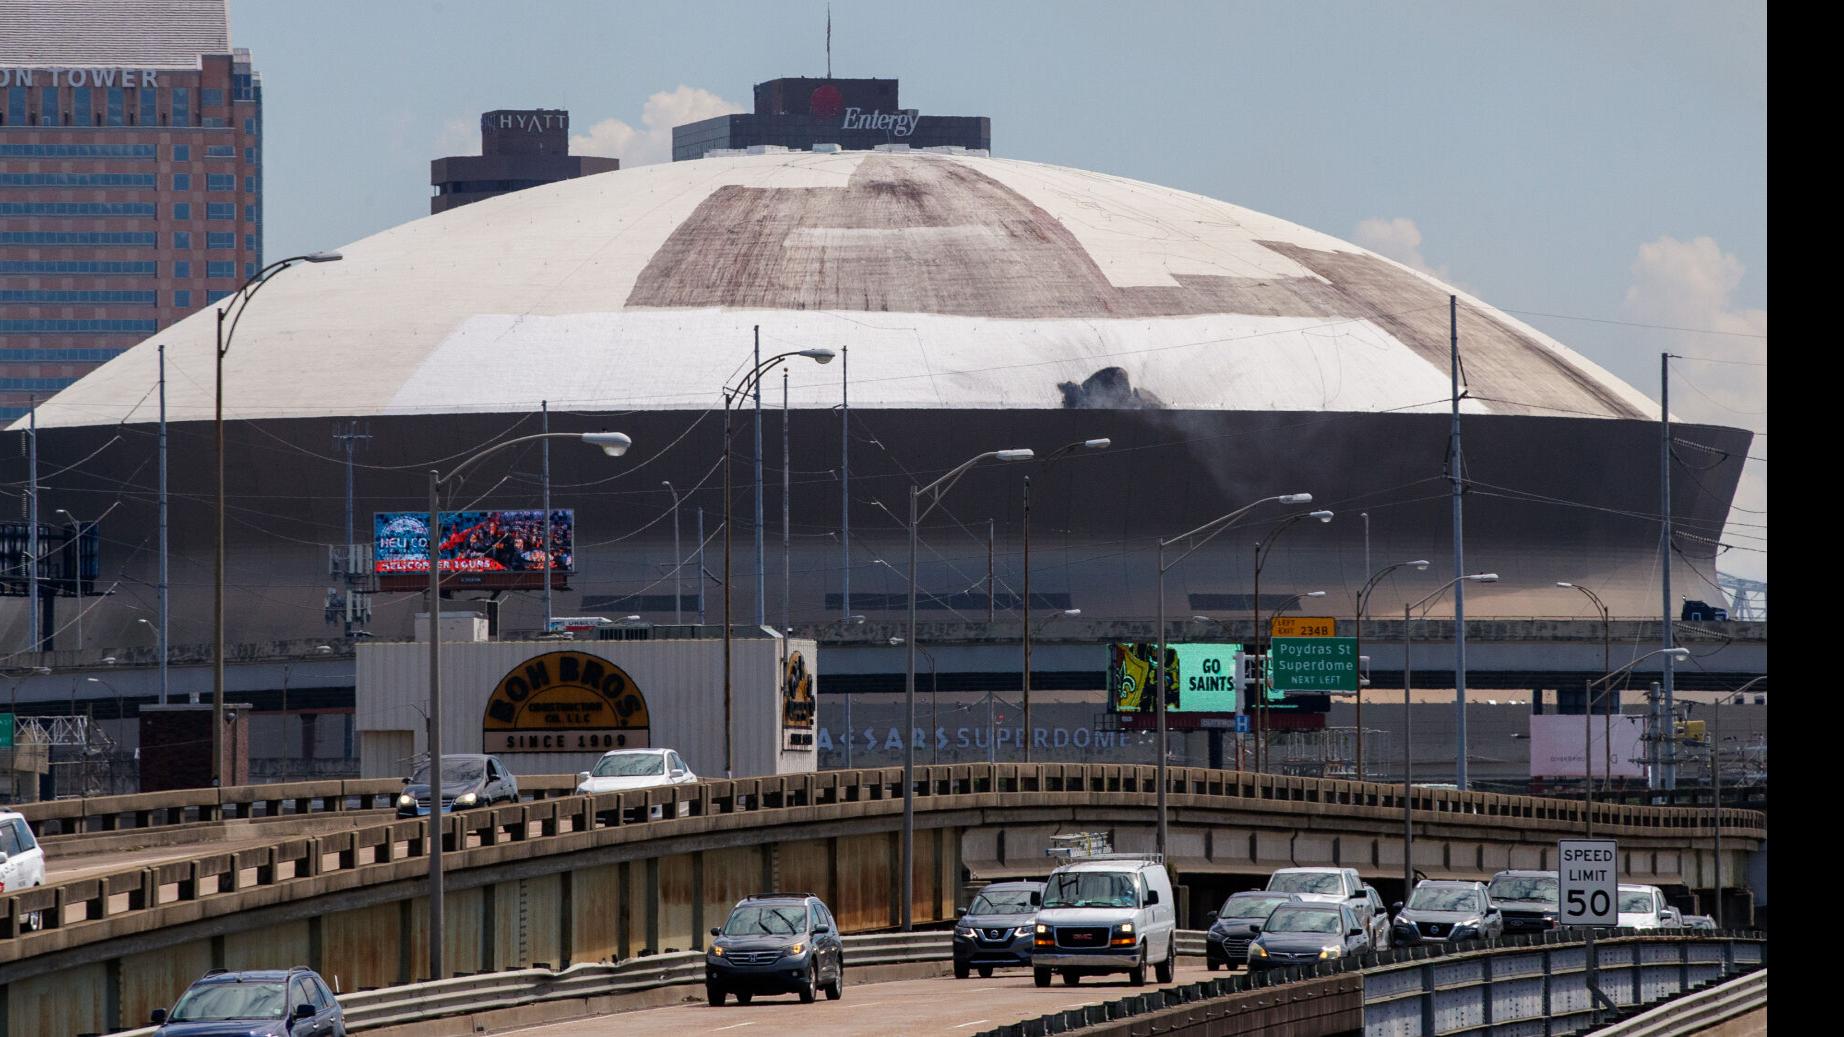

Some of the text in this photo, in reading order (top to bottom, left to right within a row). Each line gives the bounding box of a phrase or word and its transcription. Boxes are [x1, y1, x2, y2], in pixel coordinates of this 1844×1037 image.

[49, 69, 158, 88] TOWER
[500, 115, 566, 132] HYATT
[841, 107, 920, 136] Entergy
[382, 560, 450, 570] HELICOPER
[1300, 626, 1328, 636] 234B
[1280, 644, 1351, 657] Poydras St
[1202, 658, 1220, 674] GO
[1279, 660, 1353, 673] Superdome
[1189, 676, 1235, 692] SAINTS
[1291, 675, 1341, 684] NEXT LEFT
[489, 660, 549, 723] BOH
[507, 734, 626, 748] SINCE 1909
[956, 728, 1132, 748] SUPERDOME
[1563, 849, 1613, 862] SPEED
[1569, 869, 1607, 882] LIMIT
[1567, 889, 1610, 916] 50
